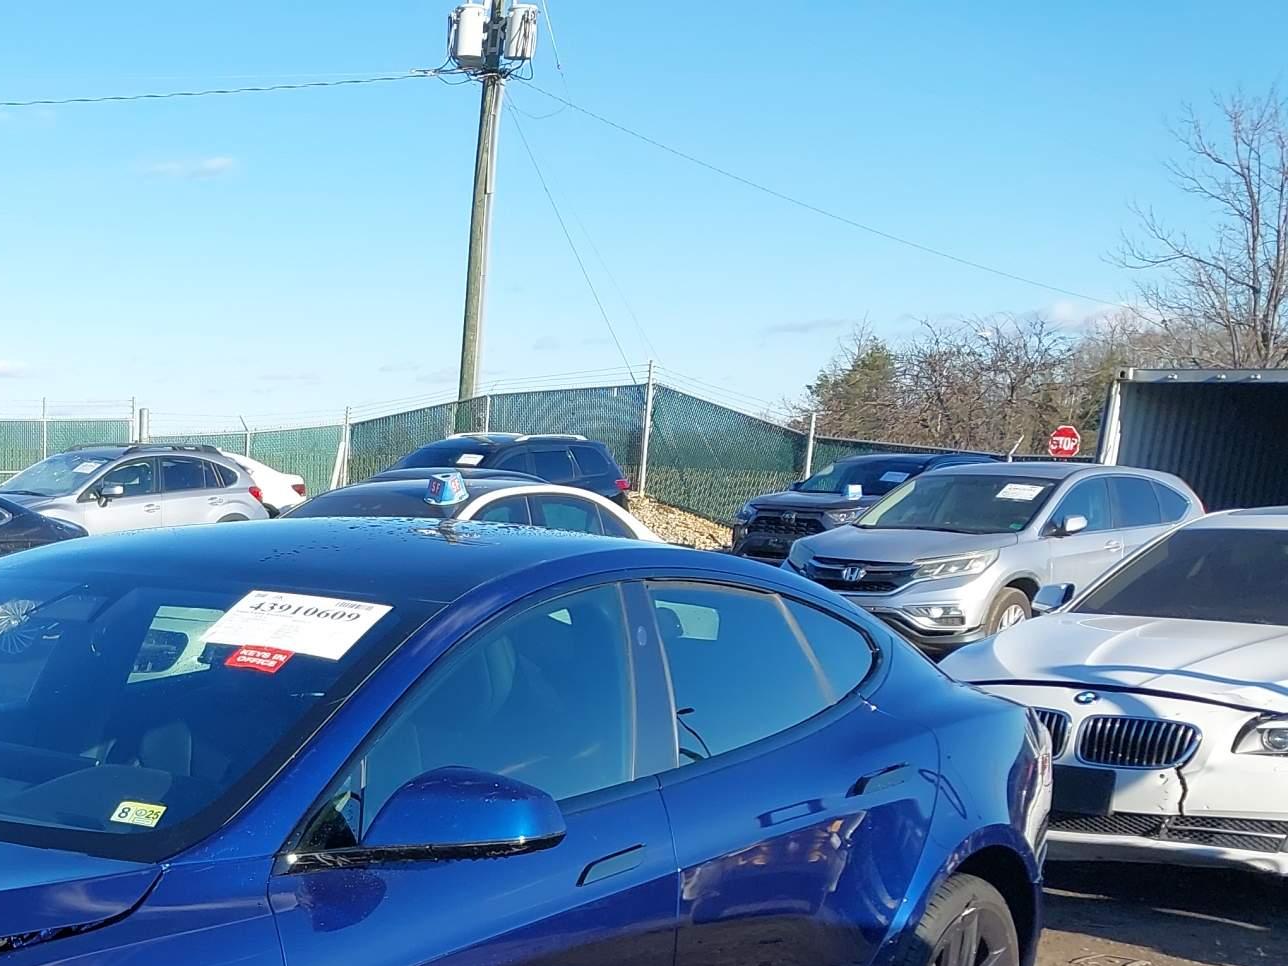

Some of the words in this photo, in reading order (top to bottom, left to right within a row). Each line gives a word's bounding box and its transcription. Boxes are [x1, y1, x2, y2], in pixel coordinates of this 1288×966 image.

[1051, 436, 1078, 450] STOP
[249, 602, 361, 621] 43910609
[236, 655, 278, 667] OFFICE
[239, 649, 271, 659] KEYS
[272, 653, 288, 662] IN
[118, 807, 131, 818] 8
[145, 809, 161, 820] 25
